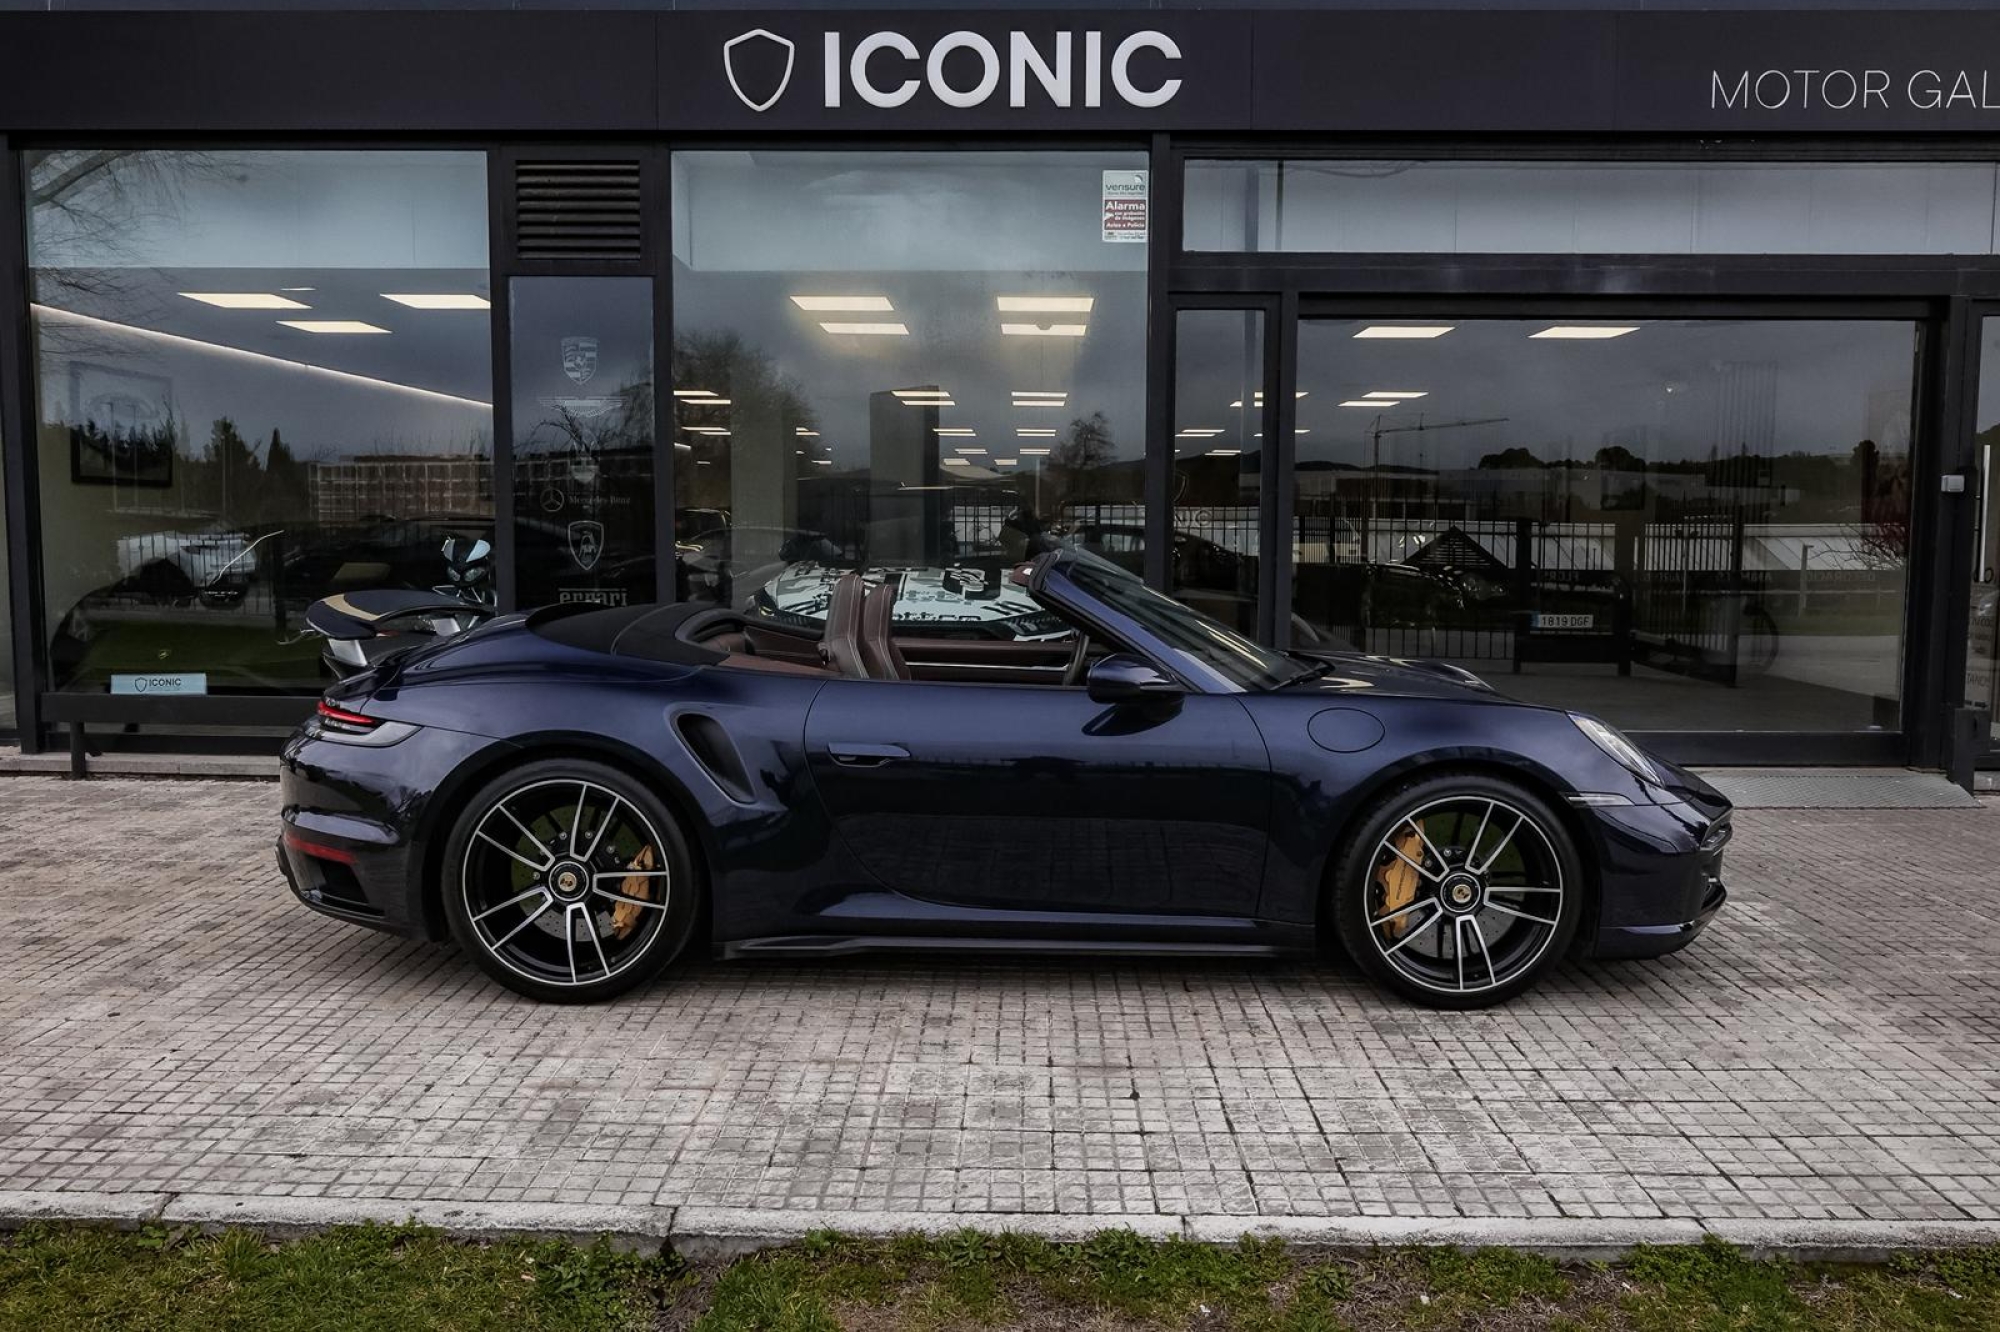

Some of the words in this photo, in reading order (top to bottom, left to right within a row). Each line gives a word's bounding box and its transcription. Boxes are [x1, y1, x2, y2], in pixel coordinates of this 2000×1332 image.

[825, 31, 1182, 107] ICONIC
[1711, 69, 1891, 109] MOTOR
[1907, 69, 2000, 109] GAL
[1105, 184, 1146, 192] verisure
[1105, 201, 1146, 210] Alarma
[1542, 616, 1568, 626] 1819
[149, 678, 182, 687] ICONIC
